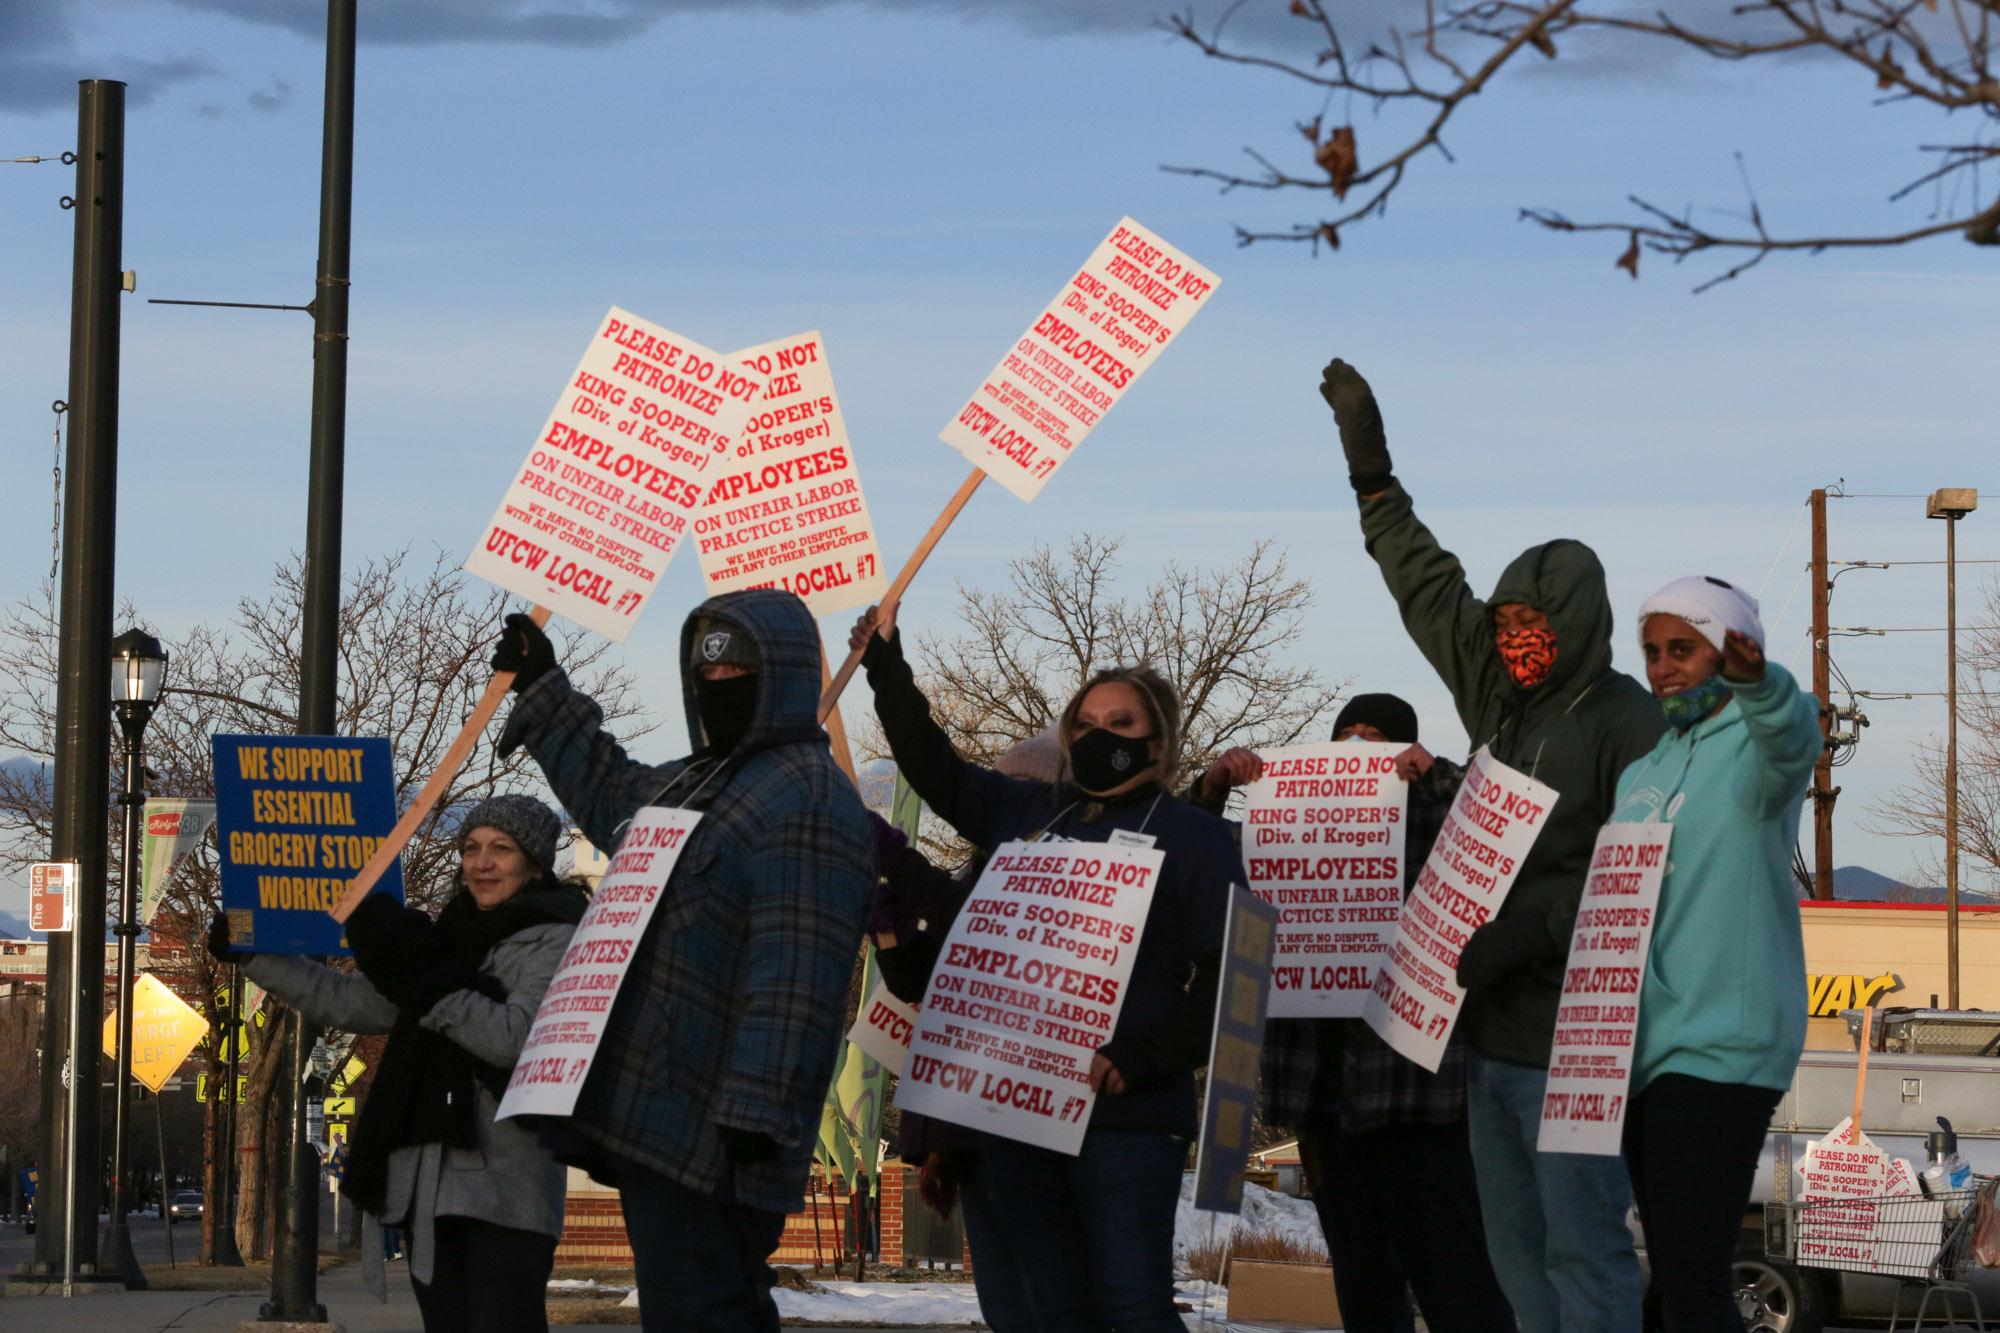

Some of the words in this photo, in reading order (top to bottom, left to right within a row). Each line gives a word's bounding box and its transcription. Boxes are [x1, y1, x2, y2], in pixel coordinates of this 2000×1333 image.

[1106, 255, 1178, 311] PATRONIZE
[1109, 227, 1163, 268] PLEASE
[1154, 257, 1182, 281] DO
[1175, 272, 1211, 301] NOT
[1062, 290, 1089, 316] (Div.
[1088, 310, 1107, 324] of
[1100, 316, 1151, 357] Kroger)
[1072, 272, 1108, 300] KING
[1104, 292, 1172, 344] SOOPER'S
[603, 318, 683, 368] PLEASE
[681, 354, 714, 382] DO
[714, 370, 760, 402] NOT
[776, 342, 817, 371] NOT
[1034, 312, 1134, 390] EMPLOYEES
[612, 352, 724, 416] PATRONIZE
[1003, 353, 1059, 397] PRACTICE
[1053, 390, 1099, 427] STRIKE
[1018, 338, 1038, 356] ON
[1034, 348, 1074, 383] UNFAIR
[1070, 376, 1113, 411] LABOR
[574, 371, 626, 406] KING
[628, 396, 730, 454] SOOPER'S
[742, 396, 833, 435] OOPER'S
[571, 394, 611, 426] (Div.
[616, 419, 640, 436] of
[638, 424, 710, 472] Kroger)
[736, 438, 755, 458] of
[758, 418, 830, 452] Kroger)
[959, 402, 1000, 436] UFCW
[989, 424, 1038, 469] LOCAL
[1034, 457, 1057, 478] #7
[544, 421, 702, 509] EMPLOYEES
[702, 446, 848, 506] MPLOYEES
[518, 469, 611, 522] PRACTICE
[609, 512, 676, 553] STRIKE
[530, 451, 561, 474] ON
[560, 463, 625, 504] UNFAIR
[624, 494, 687, 534] LABOR
[694, 514, 722, 535] ON
[725, 496, 793, 526] UNFAIR
[795, 478, 858, 508] LABOR
[505, 506, 533, 524] WITH
[534, 519, 557, 533] ANY
[559, 530, 595, 553] OTHER
[596, 547, 655, 581] EMPLOYER
[529, 503, 545, 517] WE
[546, 512, 576, 532] HAVE
[577, 526, 594, 539] NO
[595, 534, 643, 566] DISPUTE
[699, 516, 794, 554] PRACTICE
[796, 497, 862, 528] STRIKE
[726, 554, 745, 566] WE
[747, 545, 778, 561] HAVE
[780, 540, 796, 552] NO
[799, 525, 849, 547] DISPUTE
[486, 526, 549, 571] UFCW
[544, 555, 613, 606] LOCAL
[616, 592, 643, 616] #7
[710, 566, 740, 581] WITH
[742, 559, 765, 573] ANY
[769, 548, 806, 566] OTHER
[808, 531, 869, 555] EMPLOYER
[857, 553, 875, 578] #7
[238, 746, 269, 780] WE
[272, 747, 364, 782] SUPPORT
[1333, 756, 1361, 775] DO
[1366, 756, 1394, 774] NO
[252, 790, 356, 826] ESSENTIAL
[1275, 778, 1379, 798] PATRONIZE
[183, 816, 198, 833] 38
[1248, 808, 1297, 825] KING
[1304, 806, 1400, 825] SOOPER'S
[230, 831, 316, 868] GROCERY
[650, 827, 686, 848] NOT
[1256, 828, 1294, 847] (Div.
[1301, 827, 1319, 844] of
[1323, 827, 1390, 848] Kroger)
[33, 866, 44, 896] Ride
[993, 856, 1069, 874] PLEASE
[1070, 858, 1102, 879] DO
[1105, 862, 1152, 888] NOT
[1249, 857, 1398, 881] EMPLOYEES
[258, 876, 355, 912] WORKER
[1004, 876, 1118, 907] PATRONIZE
[1278, 888, 1338, 904] UNFAIR
[1343, 887, 1399, 903] LABOR
[33, 903, 44, 926] The
[968, 900, 1019, 917] KING
[1024, 905, 1135, 945] SOOPER'S
[1338, 907, 1399, 923] STRIKE
[967, 917, 1007, 936] (Div.
[1016, 926, 1037, 943] of
[1041, 928, 1120, 967] Kroger)
[1280, 944, 1300, 953] ANY
[1304, 943, 1337, 953] OTHER
[1286, 933, 1312, 944] HAVE
[1316, 933, 1331, 944] NO
[1334, 932, 1378, 943] DISPUTE
[945, 944, 1120, 1006] EMPLOYEES
[1311, 966, 1372, 990] LOCAL
[935, 974, 965, 993] ON
[968, 980, 1041, 1012] UNFAIR
[1045, 999, 1111, 1030] LABOR
[136, 1022, 182, 1043] ERGE
[928, 993, 1030, 1032] PRACTICE
[1034, 1020, 1105, 1054] STRIKE
[134, 1044, 176, 1064] LEFT
[921, 1030, 952, 1046] WITH
[955, 1038, 980, 1052] ANY
[985, 1048, 1028, 1066] OTHER
[945, 1024, 962, 1038] WE
[964, 1029, 1000, 1050] HAVE
[1000, 1040, 1022, 1056] NO
[1021, 1046, 1077, 1070] DISPUTE
[911, 1055, 978, 1092] UFCW
[981, 1074, 1054, 1117] LOCAL
[1062, 1098, 1087, 1122] #7
[1808, 1174, 1829, 1182] KING
[1820, 1161, 1867, 1173] PATRONIZE
[1848, 1153, 1858, 1162] DO
[1862, 1155, 1879, 1164] NOT
[1832, 1185, 1838, 1193] of
